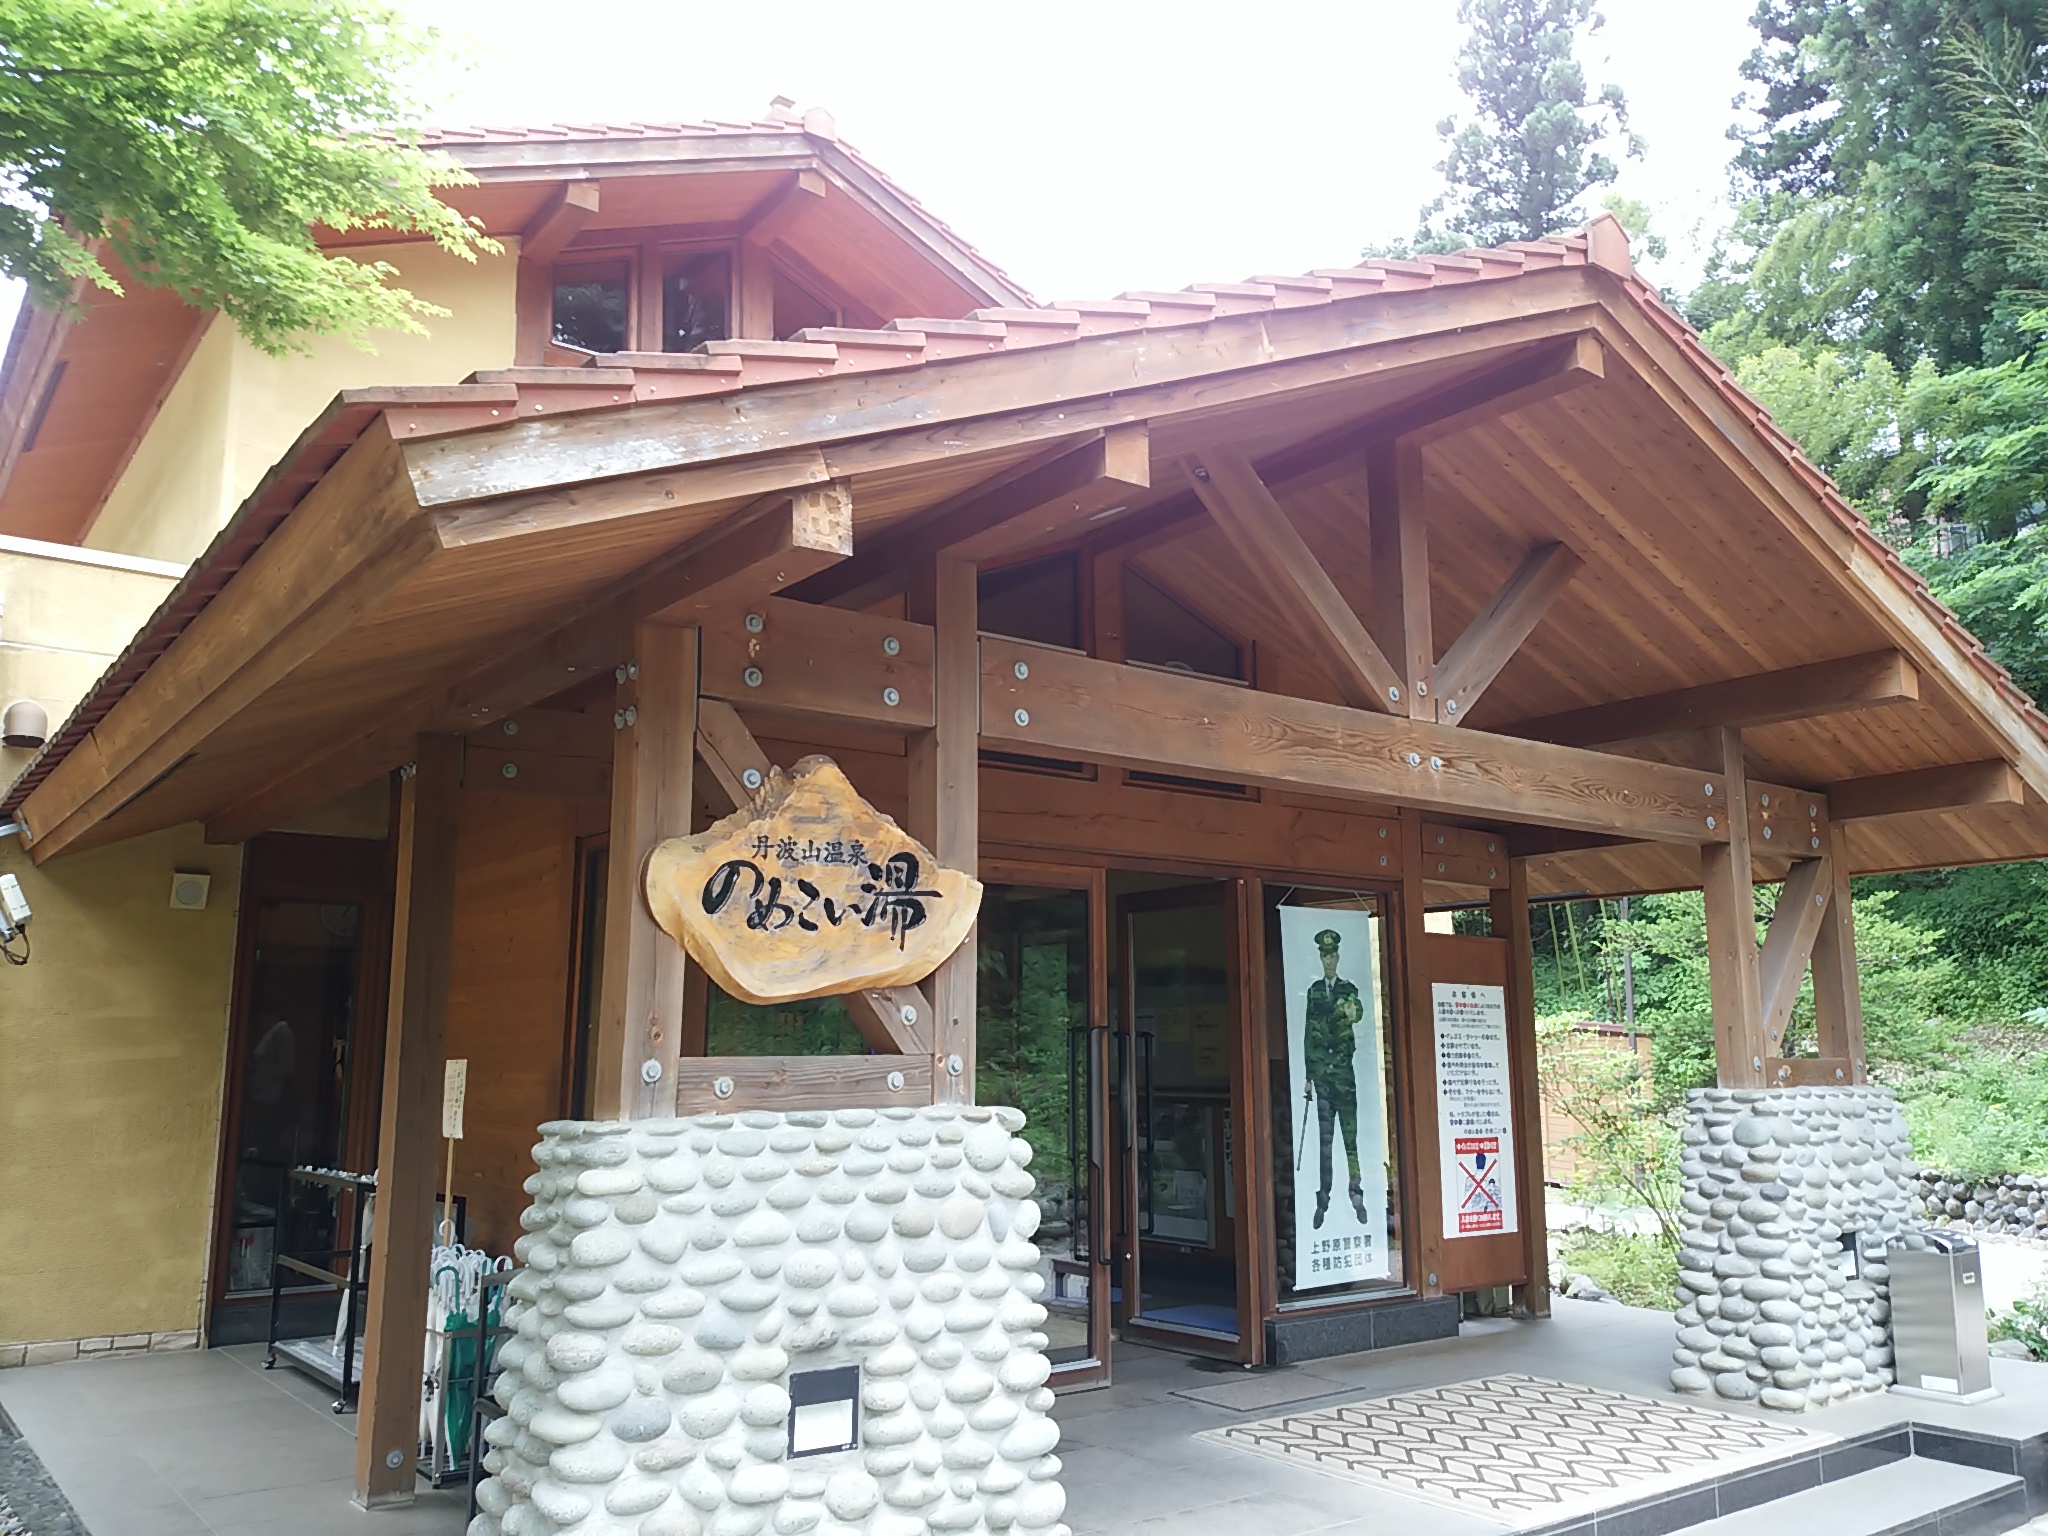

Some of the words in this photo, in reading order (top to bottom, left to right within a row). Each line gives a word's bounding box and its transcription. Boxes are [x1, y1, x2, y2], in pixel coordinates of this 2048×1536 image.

[752, 835, 868, 866] 丹波山温泉
[702, 851, 943, 952] のめこい湯
